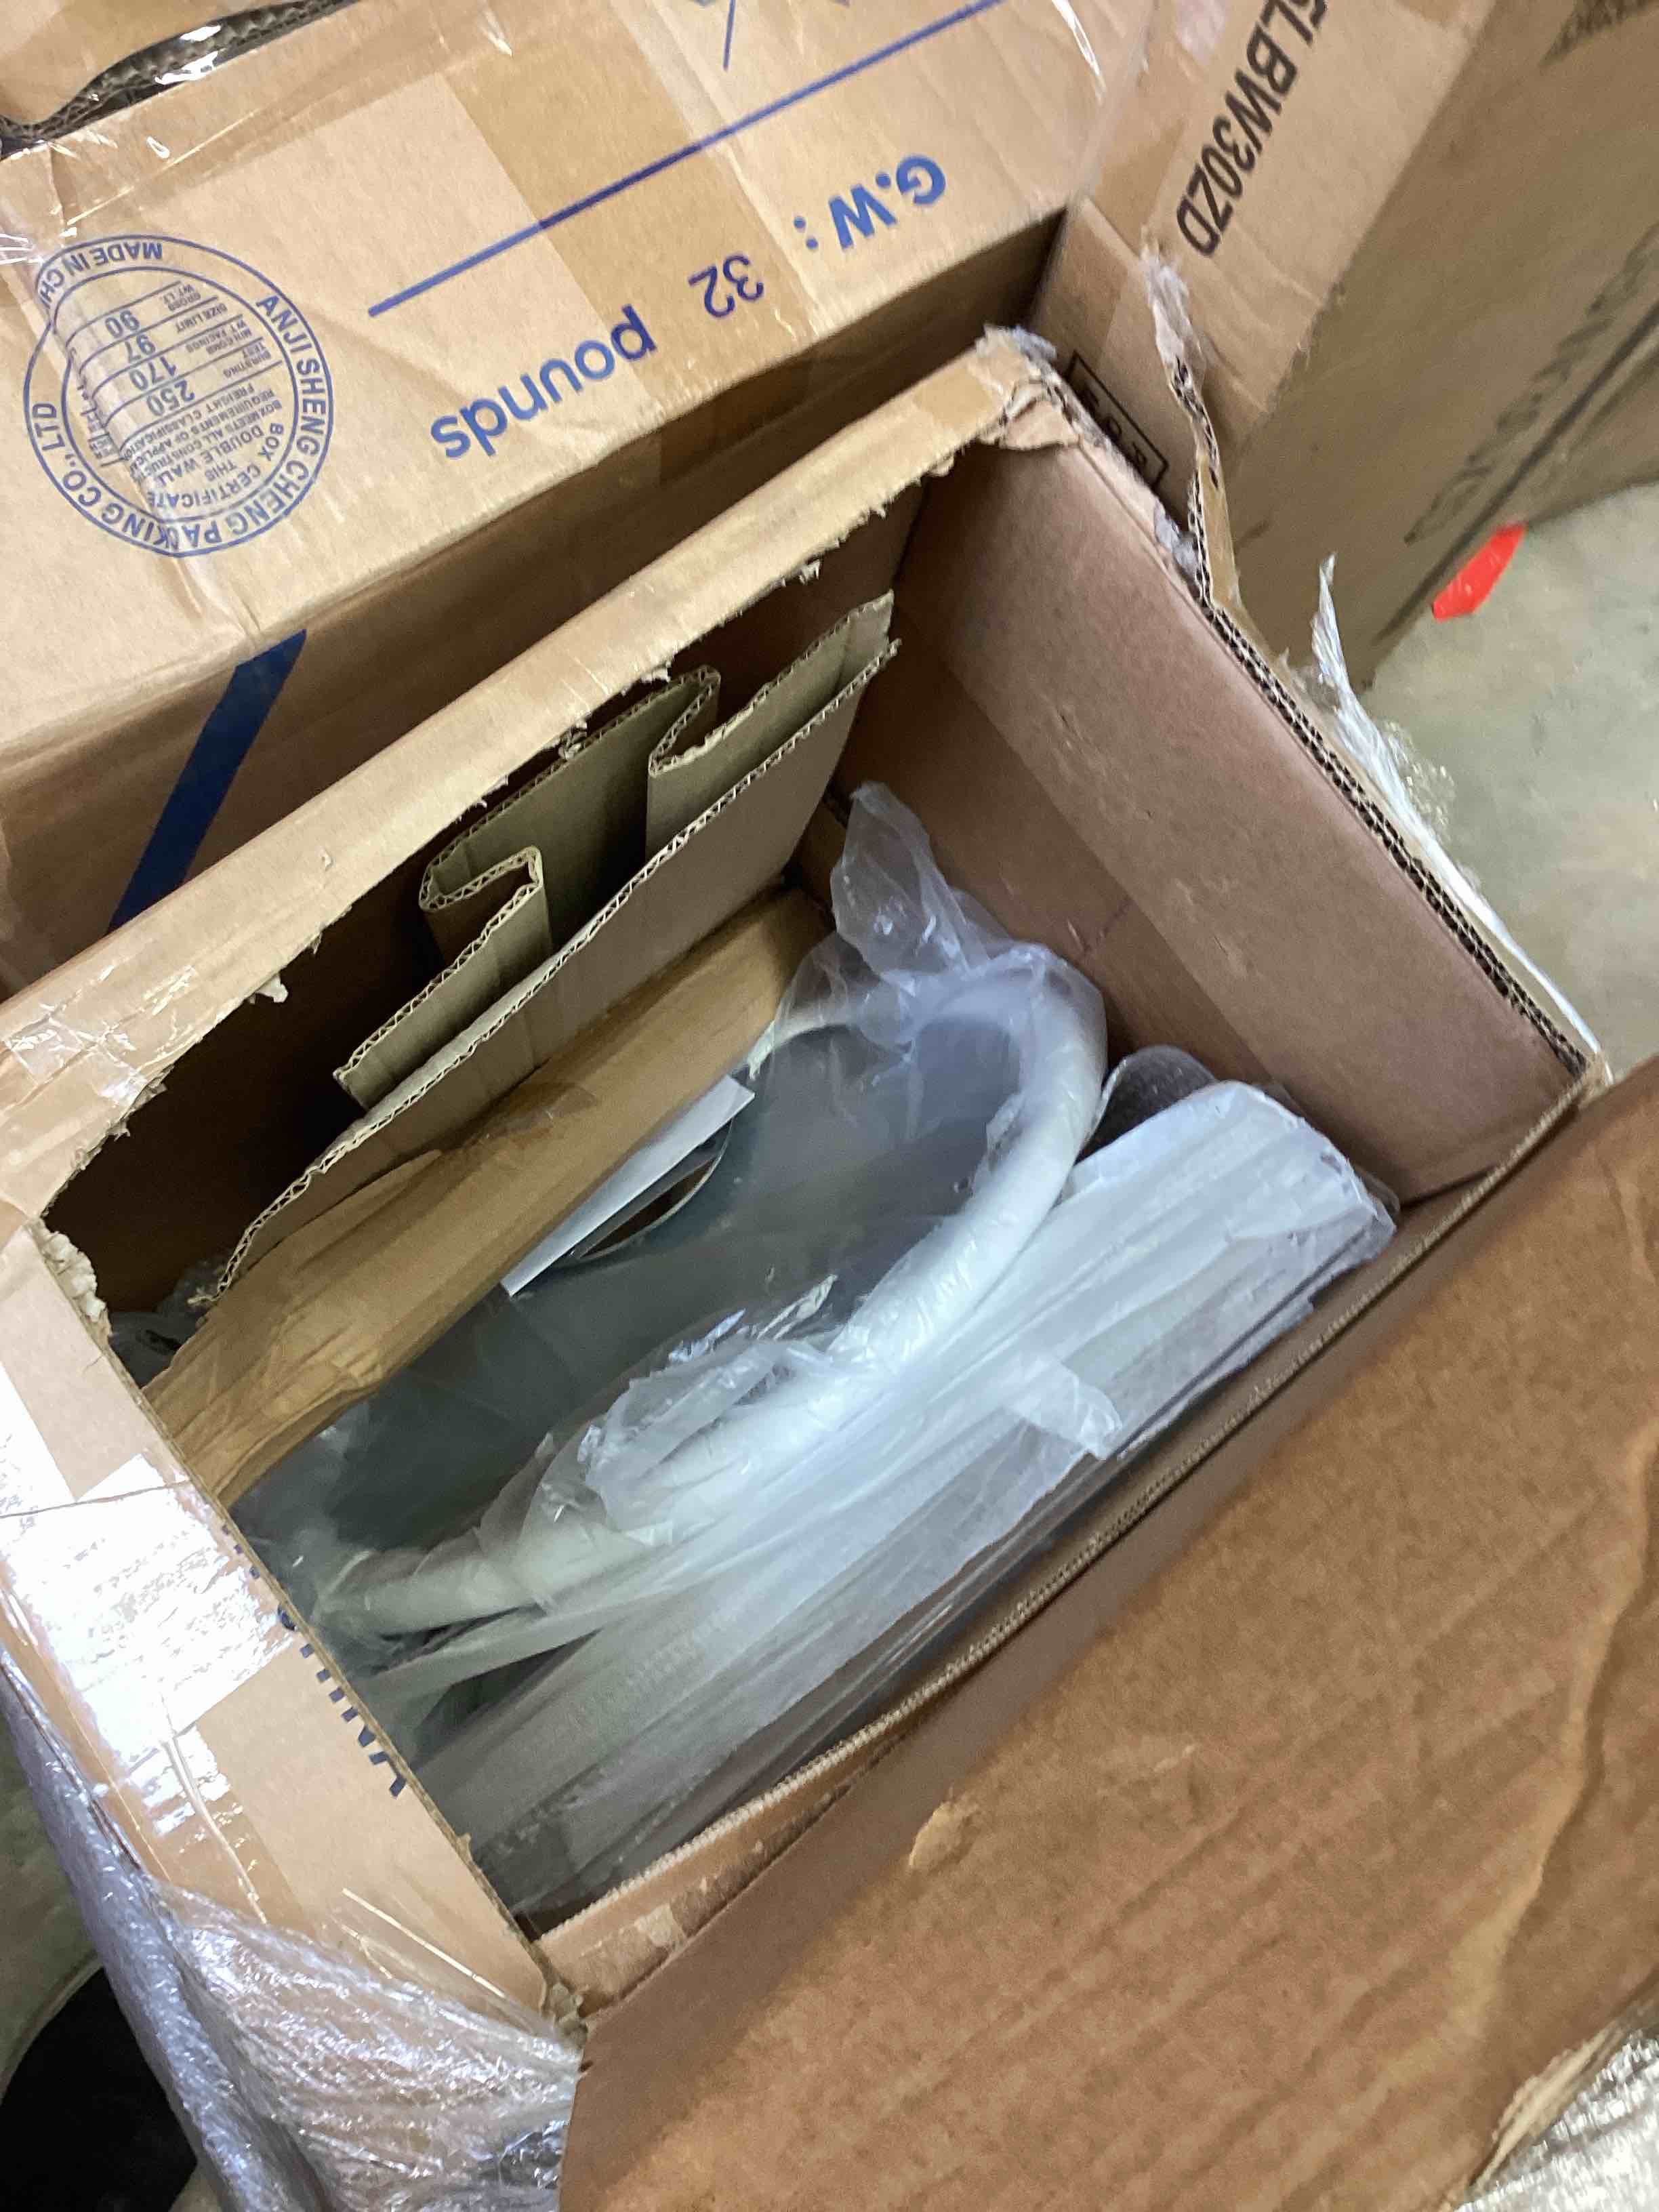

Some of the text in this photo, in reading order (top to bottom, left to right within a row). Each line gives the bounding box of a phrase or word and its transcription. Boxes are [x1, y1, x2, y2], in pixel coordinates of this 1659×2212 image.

[38, 241, 163, 310] MADE IN CHI
[687, 253, 764, 319] 32
[105, 310, 140, 338] 90
[175, 314, 204, 333] LIMIT
[256, 295, 312, 353] ANJI
[124, 334, 156, 363] 97
[129, 356, 178, 392] 170
[430, 304, 657, 461] pounds
[146, 380, 195, 416] 250
[190, 389, 274, 434] REQUIREMENTS
[296, 359, 327, 456] SHENG
[33, 403, 65, 451] LTD
[174, 432, 189, 443] OF
[203, 429, 224, 444] ALL
[148, 423, 284, 508] BOX CERTIFICATE
[154, 425, 264, 487] DOUBLE WALL
[205, 460, 237, 481] THIS
[226, 460, 310, 535] CHENG
[102, 503, 222, 550] PACKING
